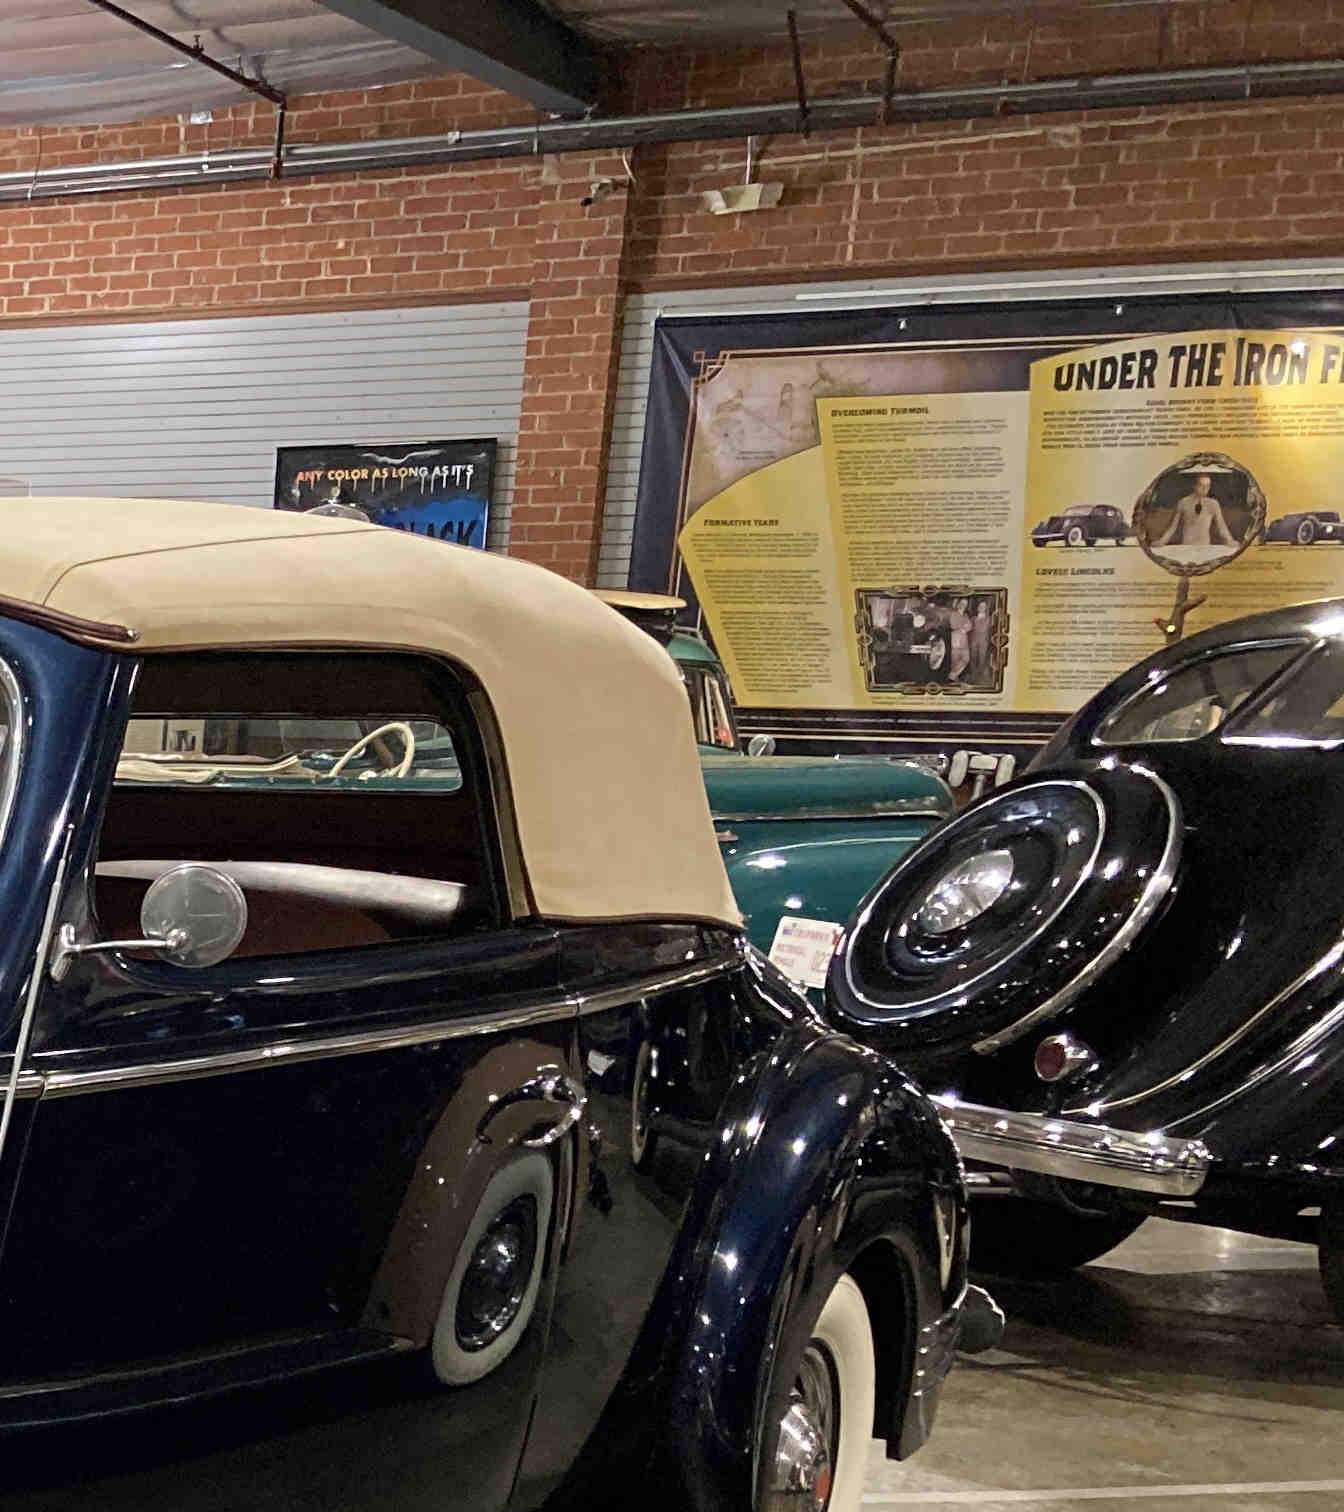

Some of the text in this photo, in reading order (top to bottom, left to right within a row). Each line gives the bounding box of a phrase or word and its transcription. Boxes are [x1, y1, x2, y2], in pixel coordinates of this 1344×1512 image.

[1053, 348, 1160, 392] UNDER
[1168, 342, 1227, 389] THE
[1233, 337, 1310, 386] IRON
[328, 468, 369, 482] COLOR
[392, 466, 429, 480] LONG
